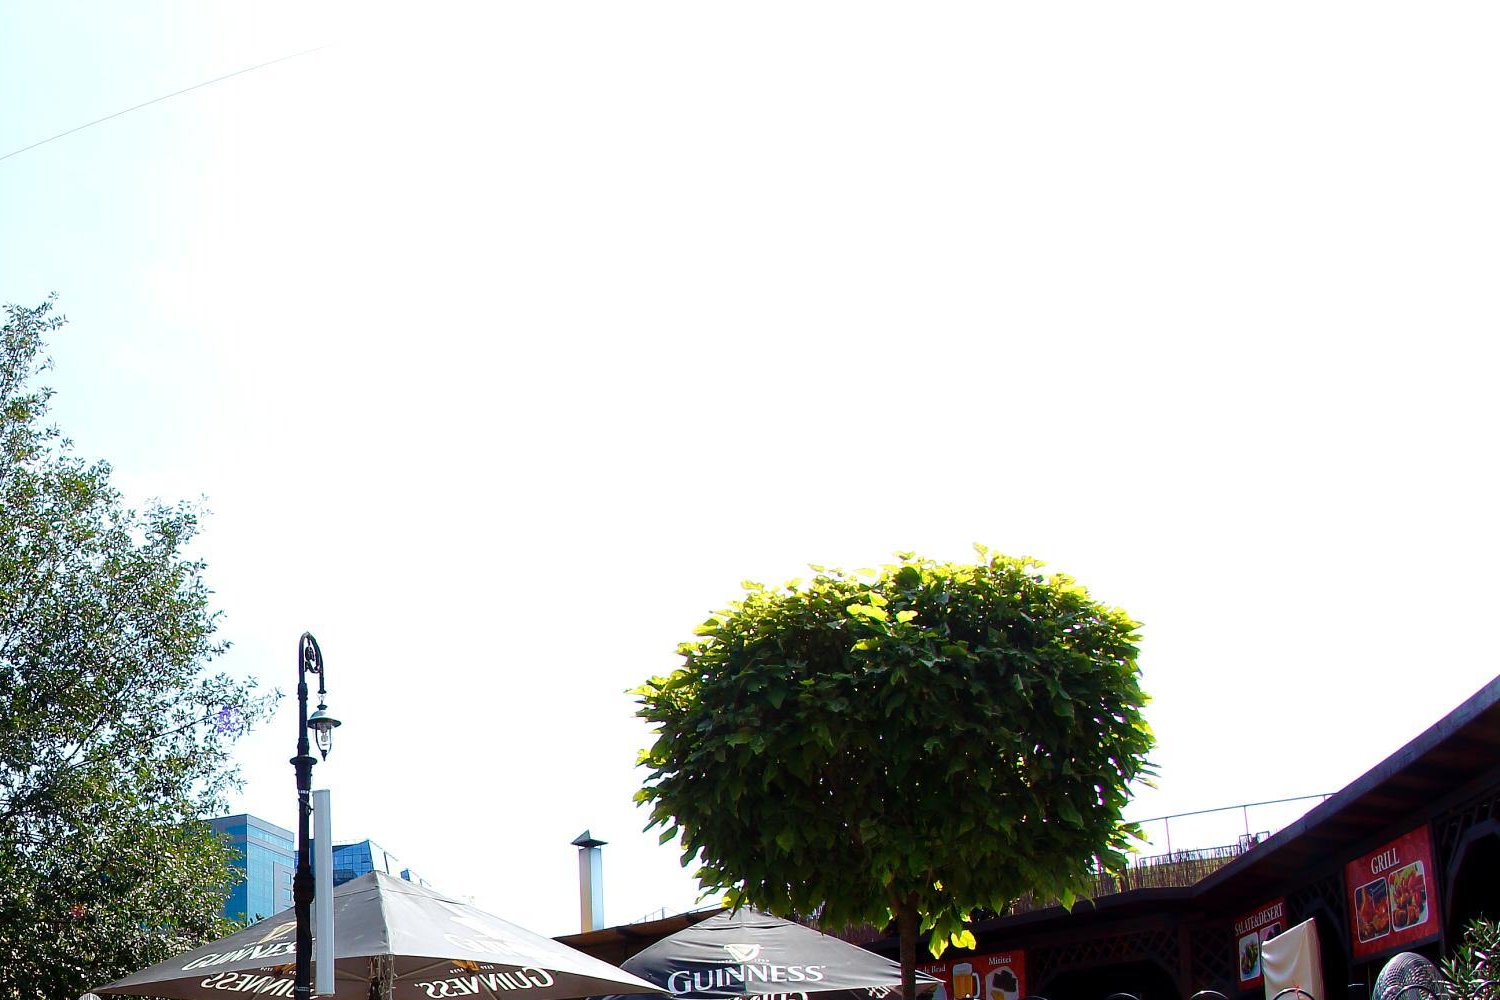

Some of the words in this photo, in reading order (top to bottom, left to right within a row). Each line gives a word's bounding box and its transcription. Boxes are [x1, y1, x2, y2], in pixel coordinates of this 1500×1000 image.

[1370, 847, 1400, 875] GRILL
[182, 941, 297, 971] GUINNES
[667, 964, 825, 995] GUINNESS
